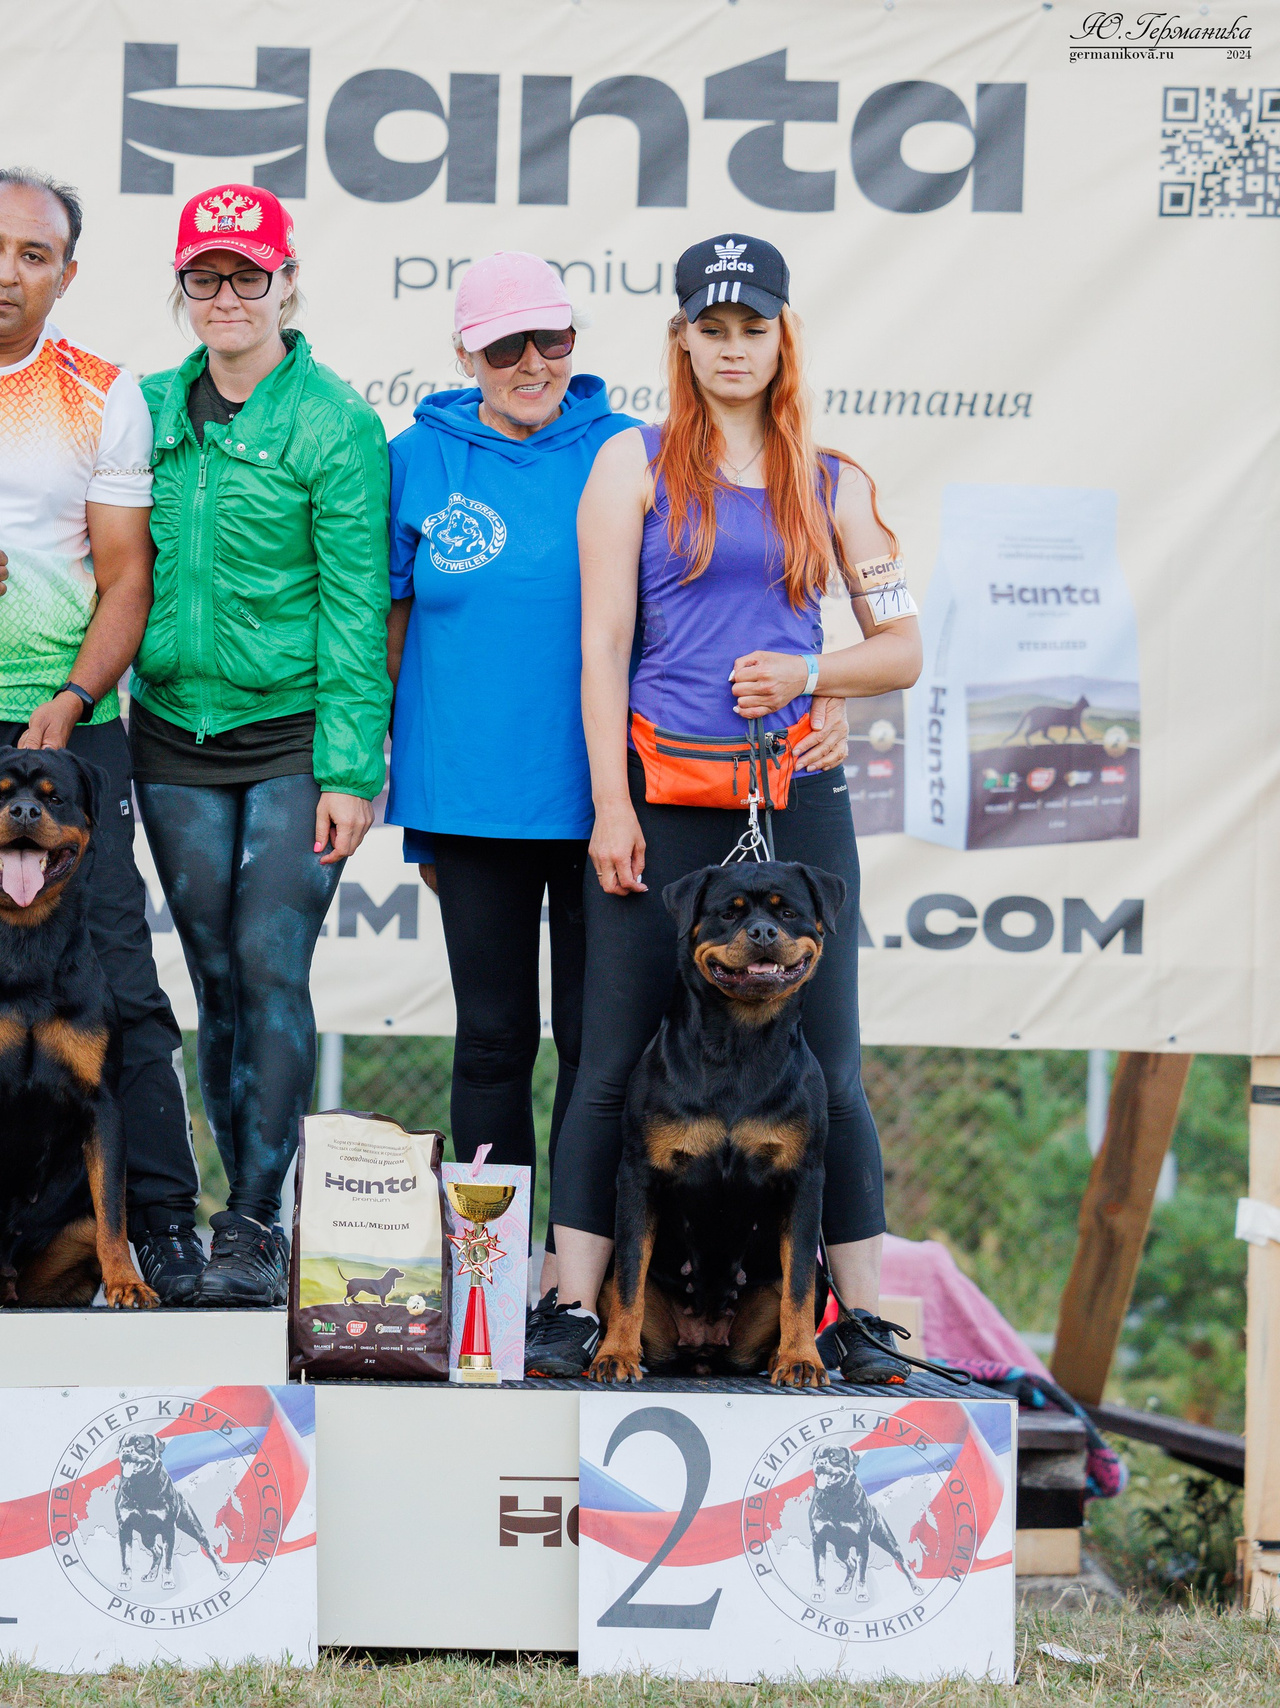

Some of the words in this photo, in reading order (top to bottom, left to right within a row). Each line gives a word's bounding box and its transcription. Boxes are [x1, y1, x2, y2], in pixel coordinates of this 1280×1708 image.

[120, 42, 1027, 214] Hanta
[394, 250, 677, 299] prmiu
[704, 260, 755, 274] adidas
[824, 388, 1033, 419] питания
[469, 501, 498, 522] TORRA
[433, 552, 489, 571] ROTTWEILER
[988, 583, 1101, 606] Hanta
[928, 686, 947, 826] Hanta
[325, 1171, 417, 1194] Hanta
[333, 1220, 410, 1231] SMALL/MEDIUM
[53, 1404, 140, 1569] РОТВЕЙЛЕР
[158, 1400, 236, 1436] КЛУБ
[241, 1442, 280, 1567] РОССИИ
[746, 1417, 834, 1577] РОТВЕЙЛЕР
[852, 1413, 931, 1451] КЛУБ
[936, 1458, 974, 1583] РОССИИ
[596, 1406, 723, 1630] 2
[106, 1590, 232, 1625] РКФ-НКПР
[800, 1605, 926, 1639] РКФ-НКПР
